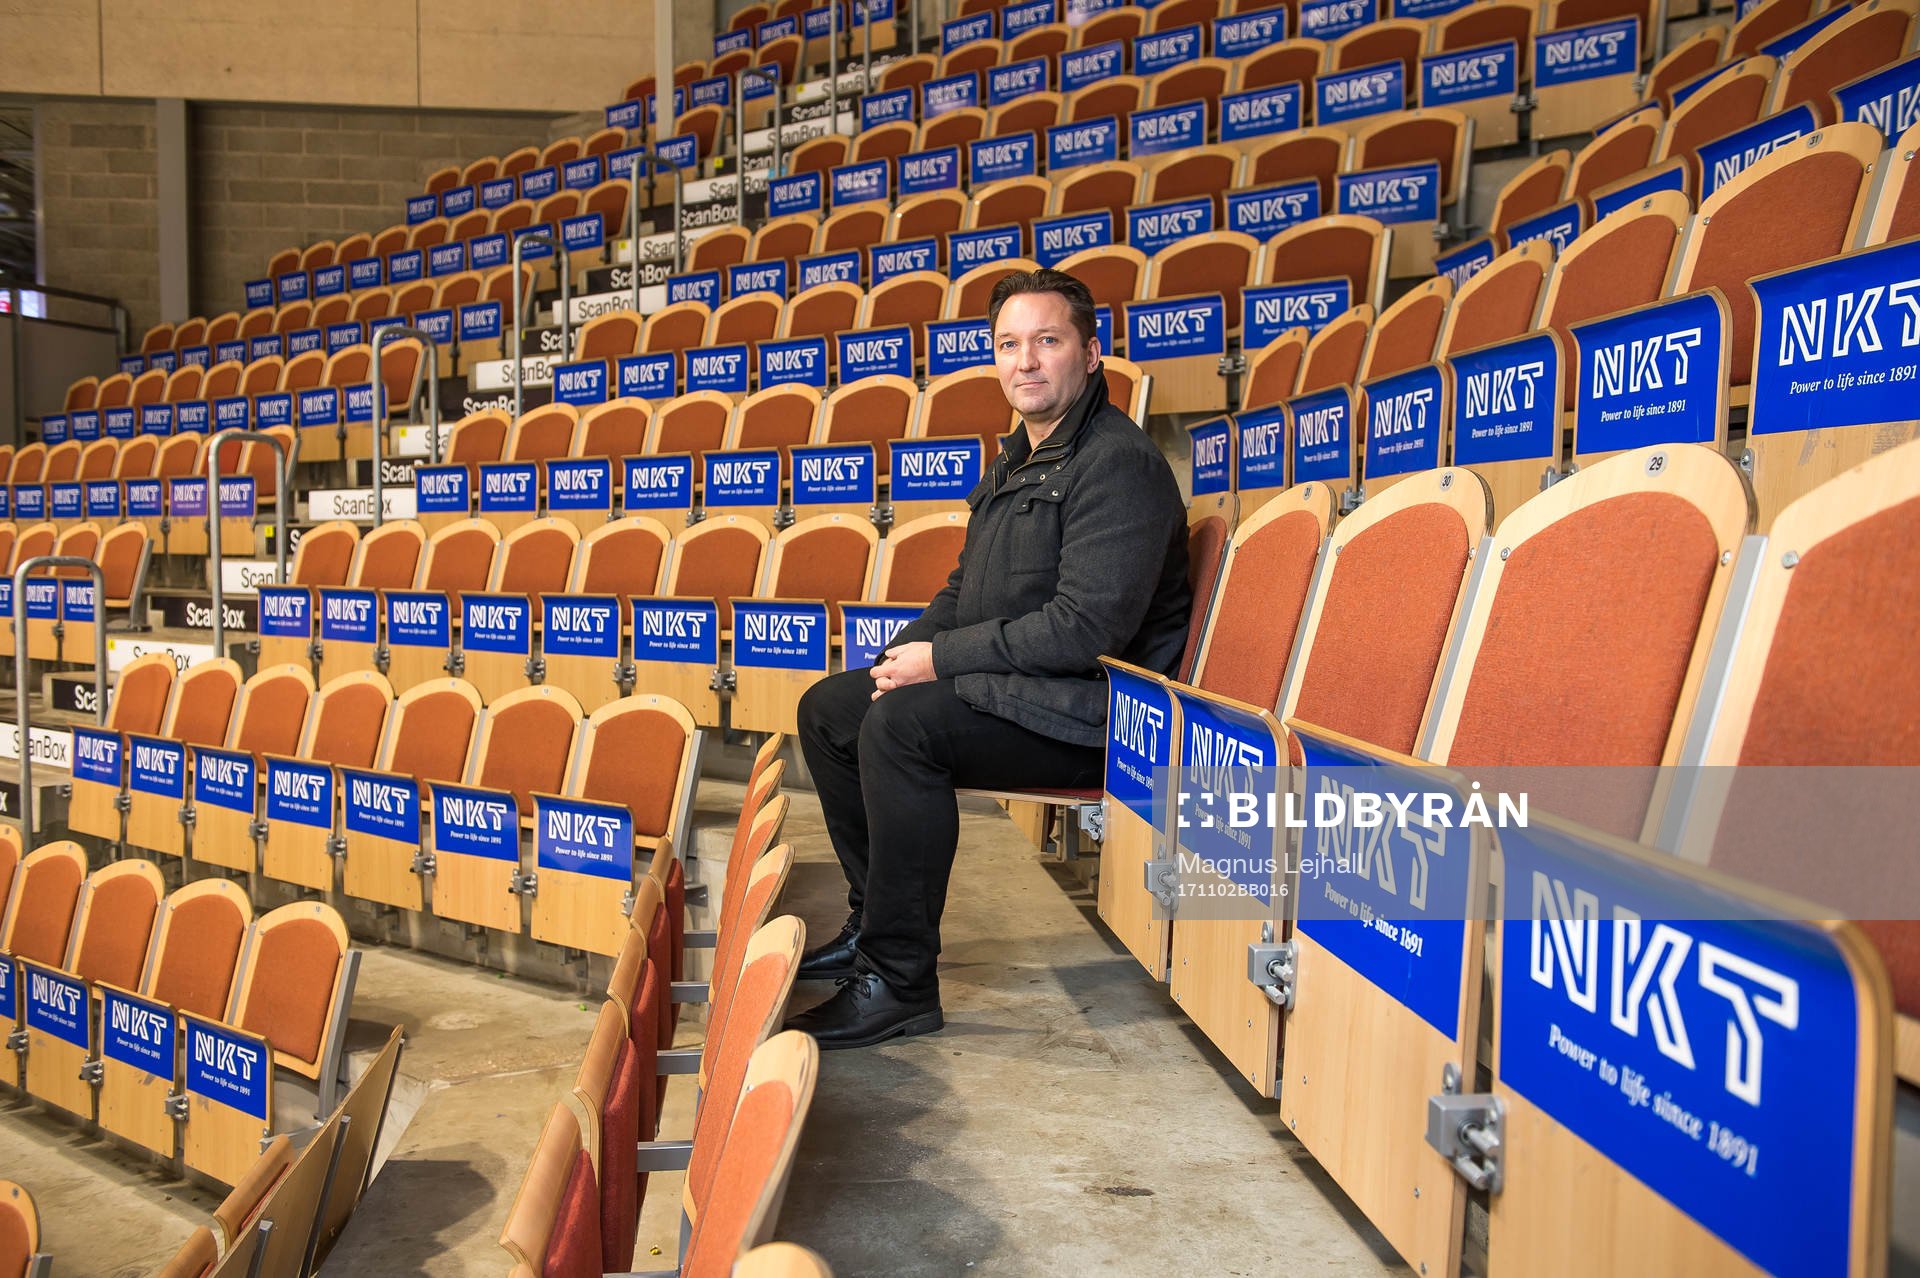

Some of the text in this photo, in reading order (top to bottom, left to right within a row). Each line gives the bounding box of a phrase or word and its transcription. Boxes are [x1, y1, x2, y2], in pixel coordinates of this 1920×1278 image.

[1007, 4, 1050, 27] NKT
[1307, 3, 1368, 27] NKT
[947, 19, 987, 43] NKT
[1221, 16, 1277, 43] NKT
[1141, 34, 1194, 60] NKT
[1545, 31, 1626, 66] NKT
[1067, 48, 1117, 74] NKT
[1432, 54, 1505, 87] NKT
[994, 67, 1040, 90] NKT
[1326, 72, 1393, 105] NKT
[928, 80, 972, 105] NKT
[866, 95, 907, 117] NKT
[1229, 93, 1291, 123] NKT
[1138, 111, 1196, 139] NKT
[659, 141, 692, 160] NKT
[1055, 126, 1109, 152] NKT
[1810, 134, 1820, 145] 31
[978, 142, 1028, 166] NKT
[838, 168, 882, 191] NKT
[905, 156, 952, 179] NKT
[774, 179, 816, 202] NKT
[1350, 173, 1427, 207] NKT
[1238, 193, 1308, 225] NKT
[566, 220, 598, 239] NKT
[1138, 209, 1202, 238] NKT
[958, 236, 1012, 261] NKT
[1043, 223, 1102, 250] NKT
[805, 261, 853, 284] NKT
[879, 249, 929, 273] NKT
[673, 280, 714, 301] NKT
[736, 270, 780, 290] NKT
[464, 309, 497, 327] NKT
[1255, 293, 1336, 325] NKT
[418, 316, 449, 333] NKT
[1139, 307, 1212, 338] NKT
[767, 348, 818, 371] NKT
[847, 338, 903, 363] NKT
[1592, 327, 1701, 399] NKT
[624, 362, 669, 384] NKT
[693, 355, 741, 376] NKT
[560, 369, 601, 391] NKT
[1465, 360, 1544, 419] NKT
[1790, 364, 1917, 394] Power to life since 1891
[303, 394, 334, 413] NKT
[1374, 387, 1433, 439] NKT
[1601, 399, 1686, 422] Power to life since 1891
[1300, 405, 1344, 447] NKT
[1472, 428, 1488, 438] Power
[1495, 425, 1504, 437] life
[1504, 424, 1518, 434] since
[1519, 421, 1533, 432] 1891
[1195, 433, 1227, 468] NKT
[1242, 422, 1280, 459] NKT
[714, 462, 770, 485] NKT
[802, 457, 864, 481] NKT
[902, 451, 970, 476] NKT
[1649, 457, 1664, 471] 29
[422, 474, 462, 494] NKT
[486, 473, 530, 493] NKT
[555, 469, 603, 490] NKT
[632, 466, 684, 489] NKT
[1442, 475, 1452, 487] 30
[174, 484, 205, 501] NKT
[27, 586, 56, 602] NKT
[265, 596, 305, 617] NKT
[327, 598, 371, 621] NKT
[393, 602, 441, 624] NKT
[470, 605, 521, 630] NKT
[552, 607, 609, 632] NKT
[643, 611, 706, 637] NKT
[745, 614, 815, 642] NKT
[856, 618, 909, 648] NK
[1114, 691, 1164, 764] NKT
[78, 736, 117, 763] NKT
[136, 746, 179, 774] NKT
[202, 756, 248, 787] NKT
[275, 770, 325, 801] NKT
[353, 780, 410, 814] NKT
[443, 797, 507, 830] NKT
[548, 810, 620, 847] NKT
[1238, 829, 1251, 850] 1891
[1325, 881, 1348, 910] Power
[1349, 899, 1358, 917] to
[1360, 902, 1374, 928] life
[1375, 914, 1399, 941] since
[33, 974, 80, 1015] NKT
[1530, 870, 1800, 1108] NKT
[112, 1000, 166, 1045] NKT
[196, 1031, 257, 1080] NKT
[1549, 1023, 1759, 1178] Power to life since 1891
